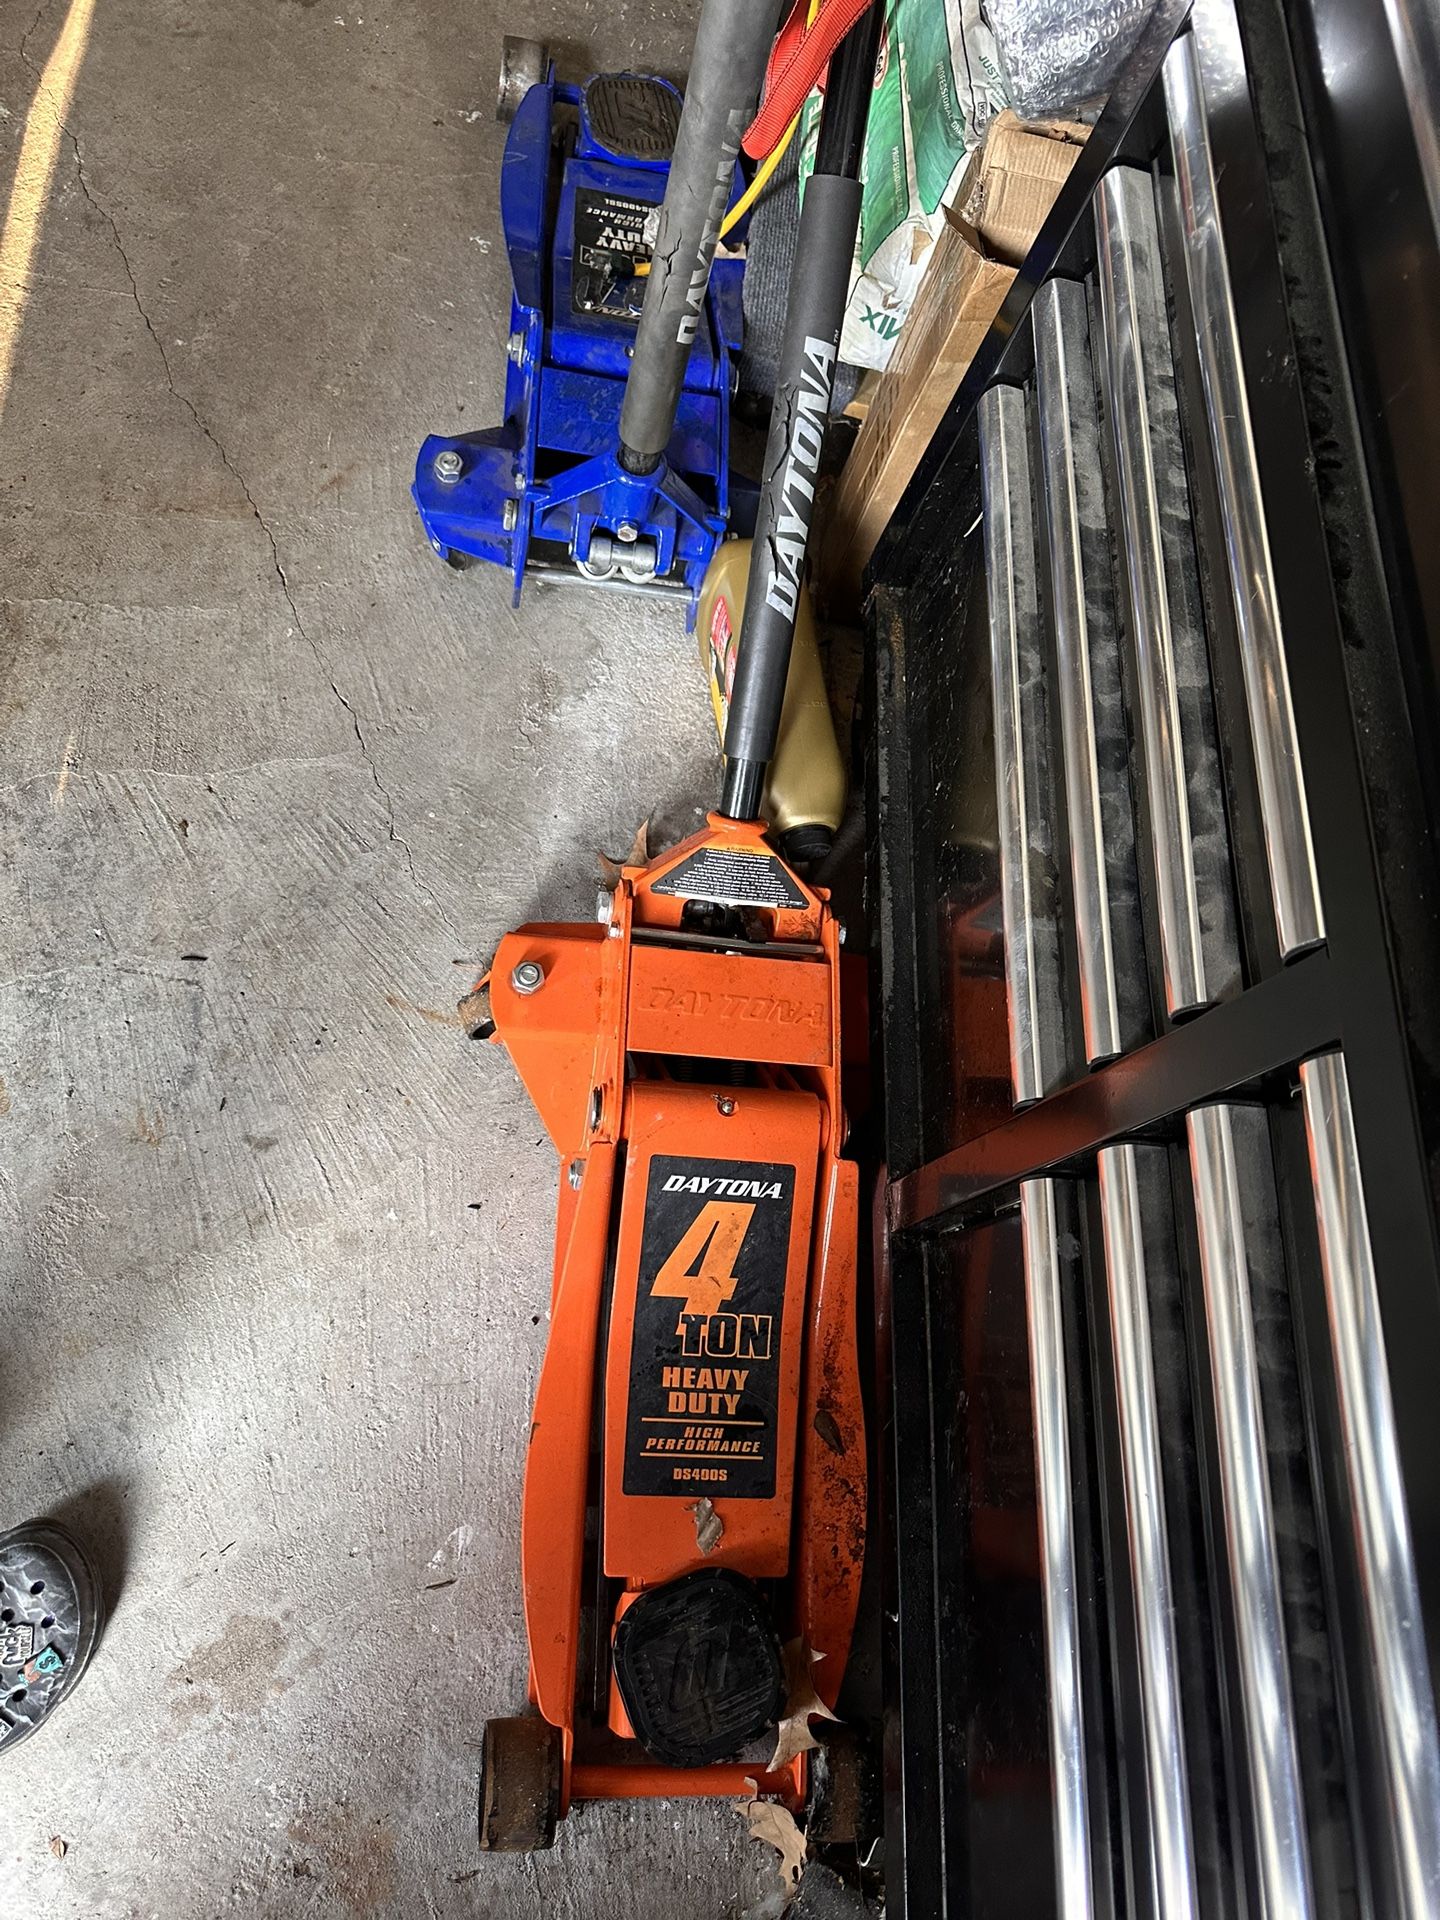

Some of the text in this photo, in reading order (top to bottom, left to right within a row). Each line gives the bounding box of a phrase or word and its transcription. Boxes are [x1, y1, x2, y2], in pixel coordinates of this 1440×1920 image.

[978, 55, 999, 84] JUST
[936, 61, 954, 121] PROFESSIONAL
[586, 207, 643, 222] ORMANCE
[601, 226, 644, 243] UTY
[764, 336, 838, 623] DAYTONA
[637, 986, 828, 1028] DAYTONA
[662, 1174, 782, 1199] DAYTONA
[650, 1200, 756, 1336] 4
[679, 1312, 773, 1360] TON
[662, 1366, 750, 1391] HEAVY
[668, 1391, 741, 1416] DUTY
[684, 1426, 724, 1439] HIGH
[645, 1437, 761, 1454] PERFORMANCE
[673, 1467, 728, 1482] DS400S
